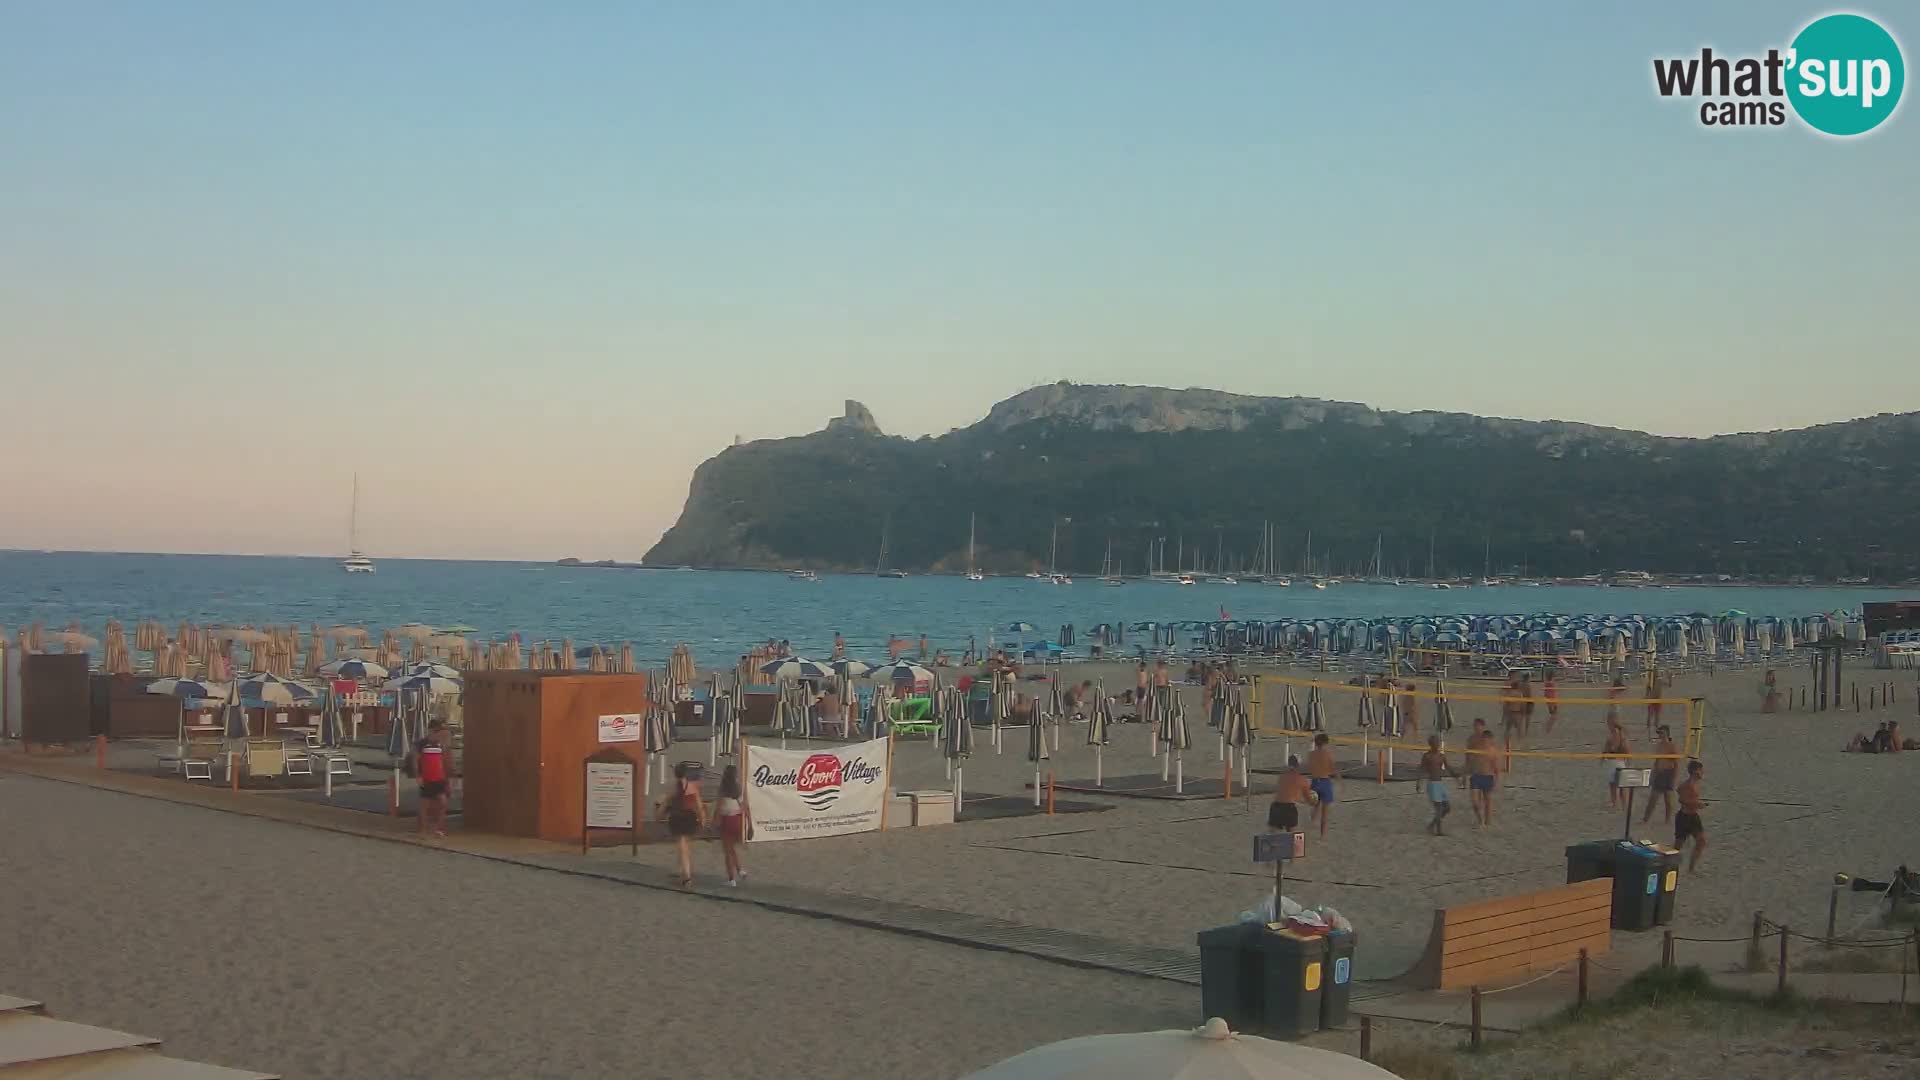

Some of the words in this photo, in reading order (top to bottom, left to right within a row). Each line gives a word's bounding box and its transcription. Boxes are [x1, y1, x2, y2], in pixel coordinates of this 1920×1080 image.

[753, 764, 797, 788] Beach
[800, 762, 841, 789] Sport
[841, 756, 882, 785] Village
